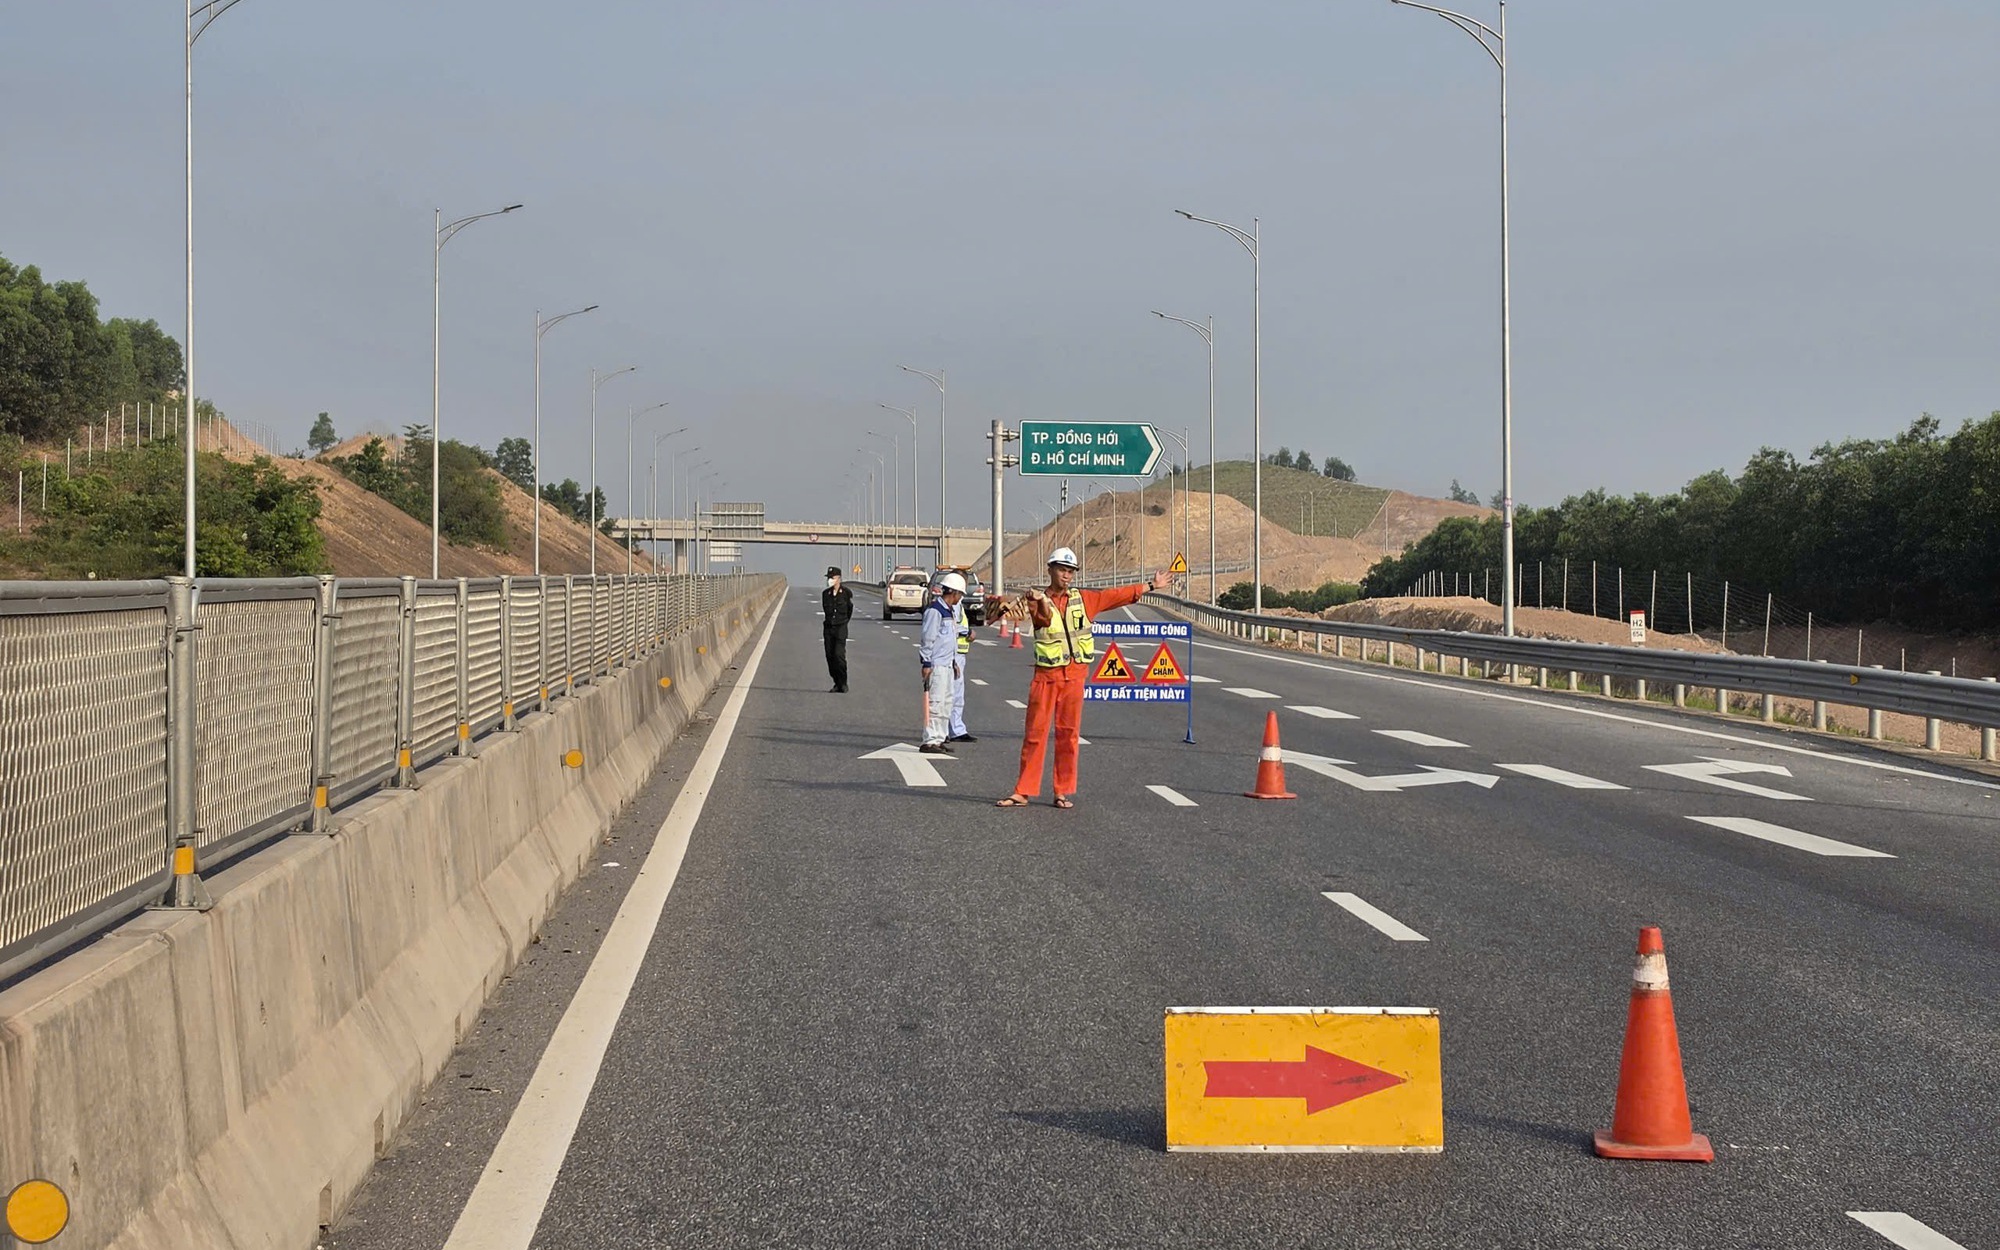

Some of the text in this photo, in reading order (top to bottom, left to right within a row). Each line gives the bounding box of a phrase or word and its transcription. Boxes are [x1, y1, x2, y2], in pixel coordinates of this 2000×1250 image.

[1031, 429, 1118, 445] TP. ĐỒNG HỚI
[1068, 450, 1090, 466] CHÍ
[1093, 454, 1125, 466] MINH
[1091, 621, 1188, 636] ỜNG ĐANG THI CÔNG
[1633, 619, 1643, 627] H2
[1094, 688, 1111, 701] SỰ
[1111, 686, 1131, 699] BẤT
[1134, 687, 1158, 701] TIỆN
[1159, 688, 1185, 700] NÀY!
